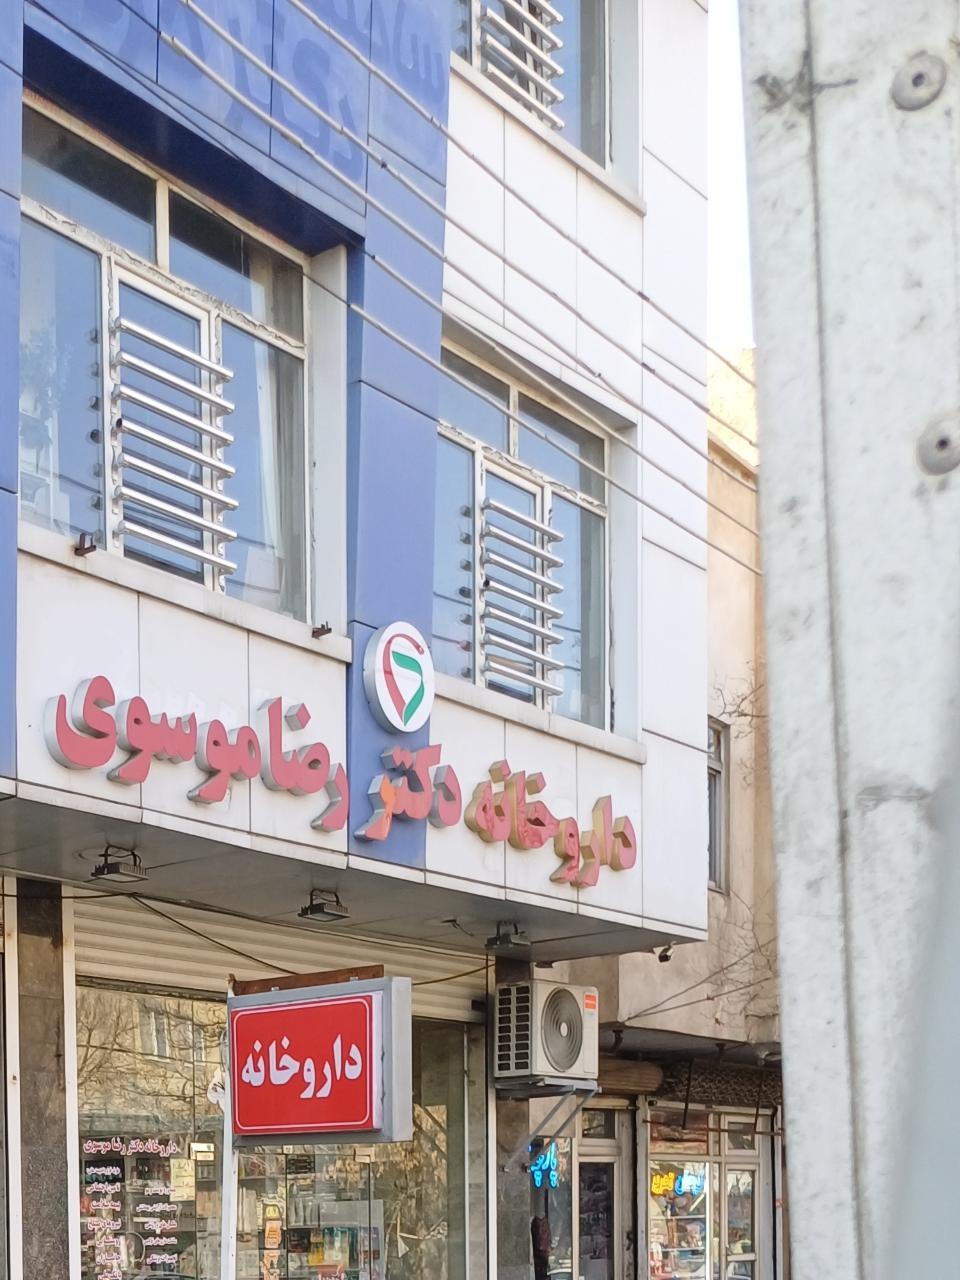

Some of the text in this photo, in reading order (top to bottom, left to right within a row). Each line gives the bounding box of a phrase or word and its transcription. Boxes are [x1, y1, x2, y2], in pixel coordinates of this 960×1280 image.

[44, 676, 637, 888] داروخانه دکتر رضا موسوی
[241, 1034, 363, 1099] داروخانه
[83, 1139, 112, 1155] موسوی
[127, 1138, 145, 1156] دکتر
[145, 1138, 178, 1157] داروخانه
